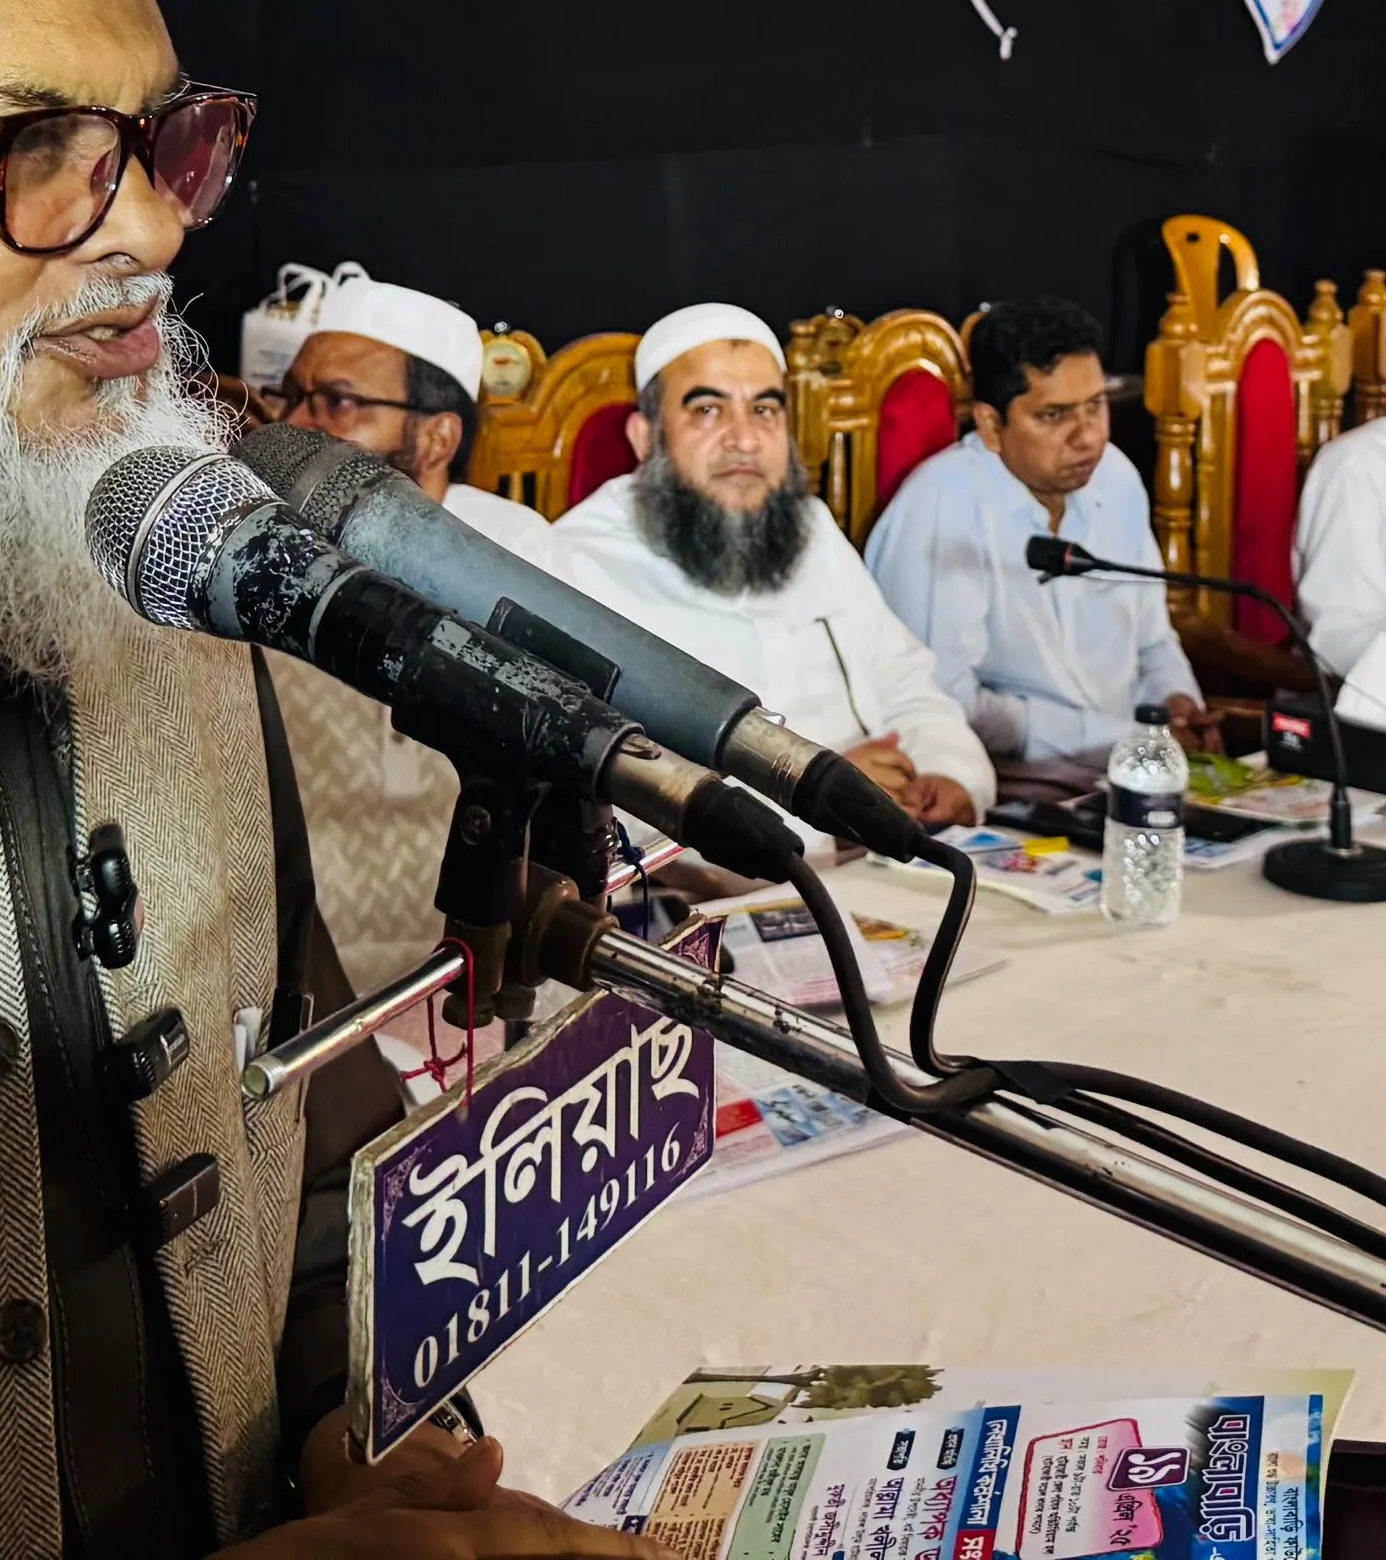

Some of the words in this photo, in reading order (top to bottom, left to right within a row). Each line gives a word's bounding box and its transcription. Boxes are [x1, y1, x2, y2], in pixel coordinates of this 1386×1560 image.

[401, 1014, 700, 1287] ইলিয়াছ
[414, 1121, 682, 1390] 01811-149116
[977, 1419, 1012, 1473] লেখালিখি
[1127, 1451, 1182, 1484] ১৯
[873, 1477, 905, 1521] আল্লামা
[966, 1473, 1002, 1526] কর্মশালা
[1199, 1414, 1256, 1543] বাংলাবাড়ি
[916, 1474, 958, 1541] অধ্যাপক
[1113, 1493, 1143, 1522] এপ্রিল
